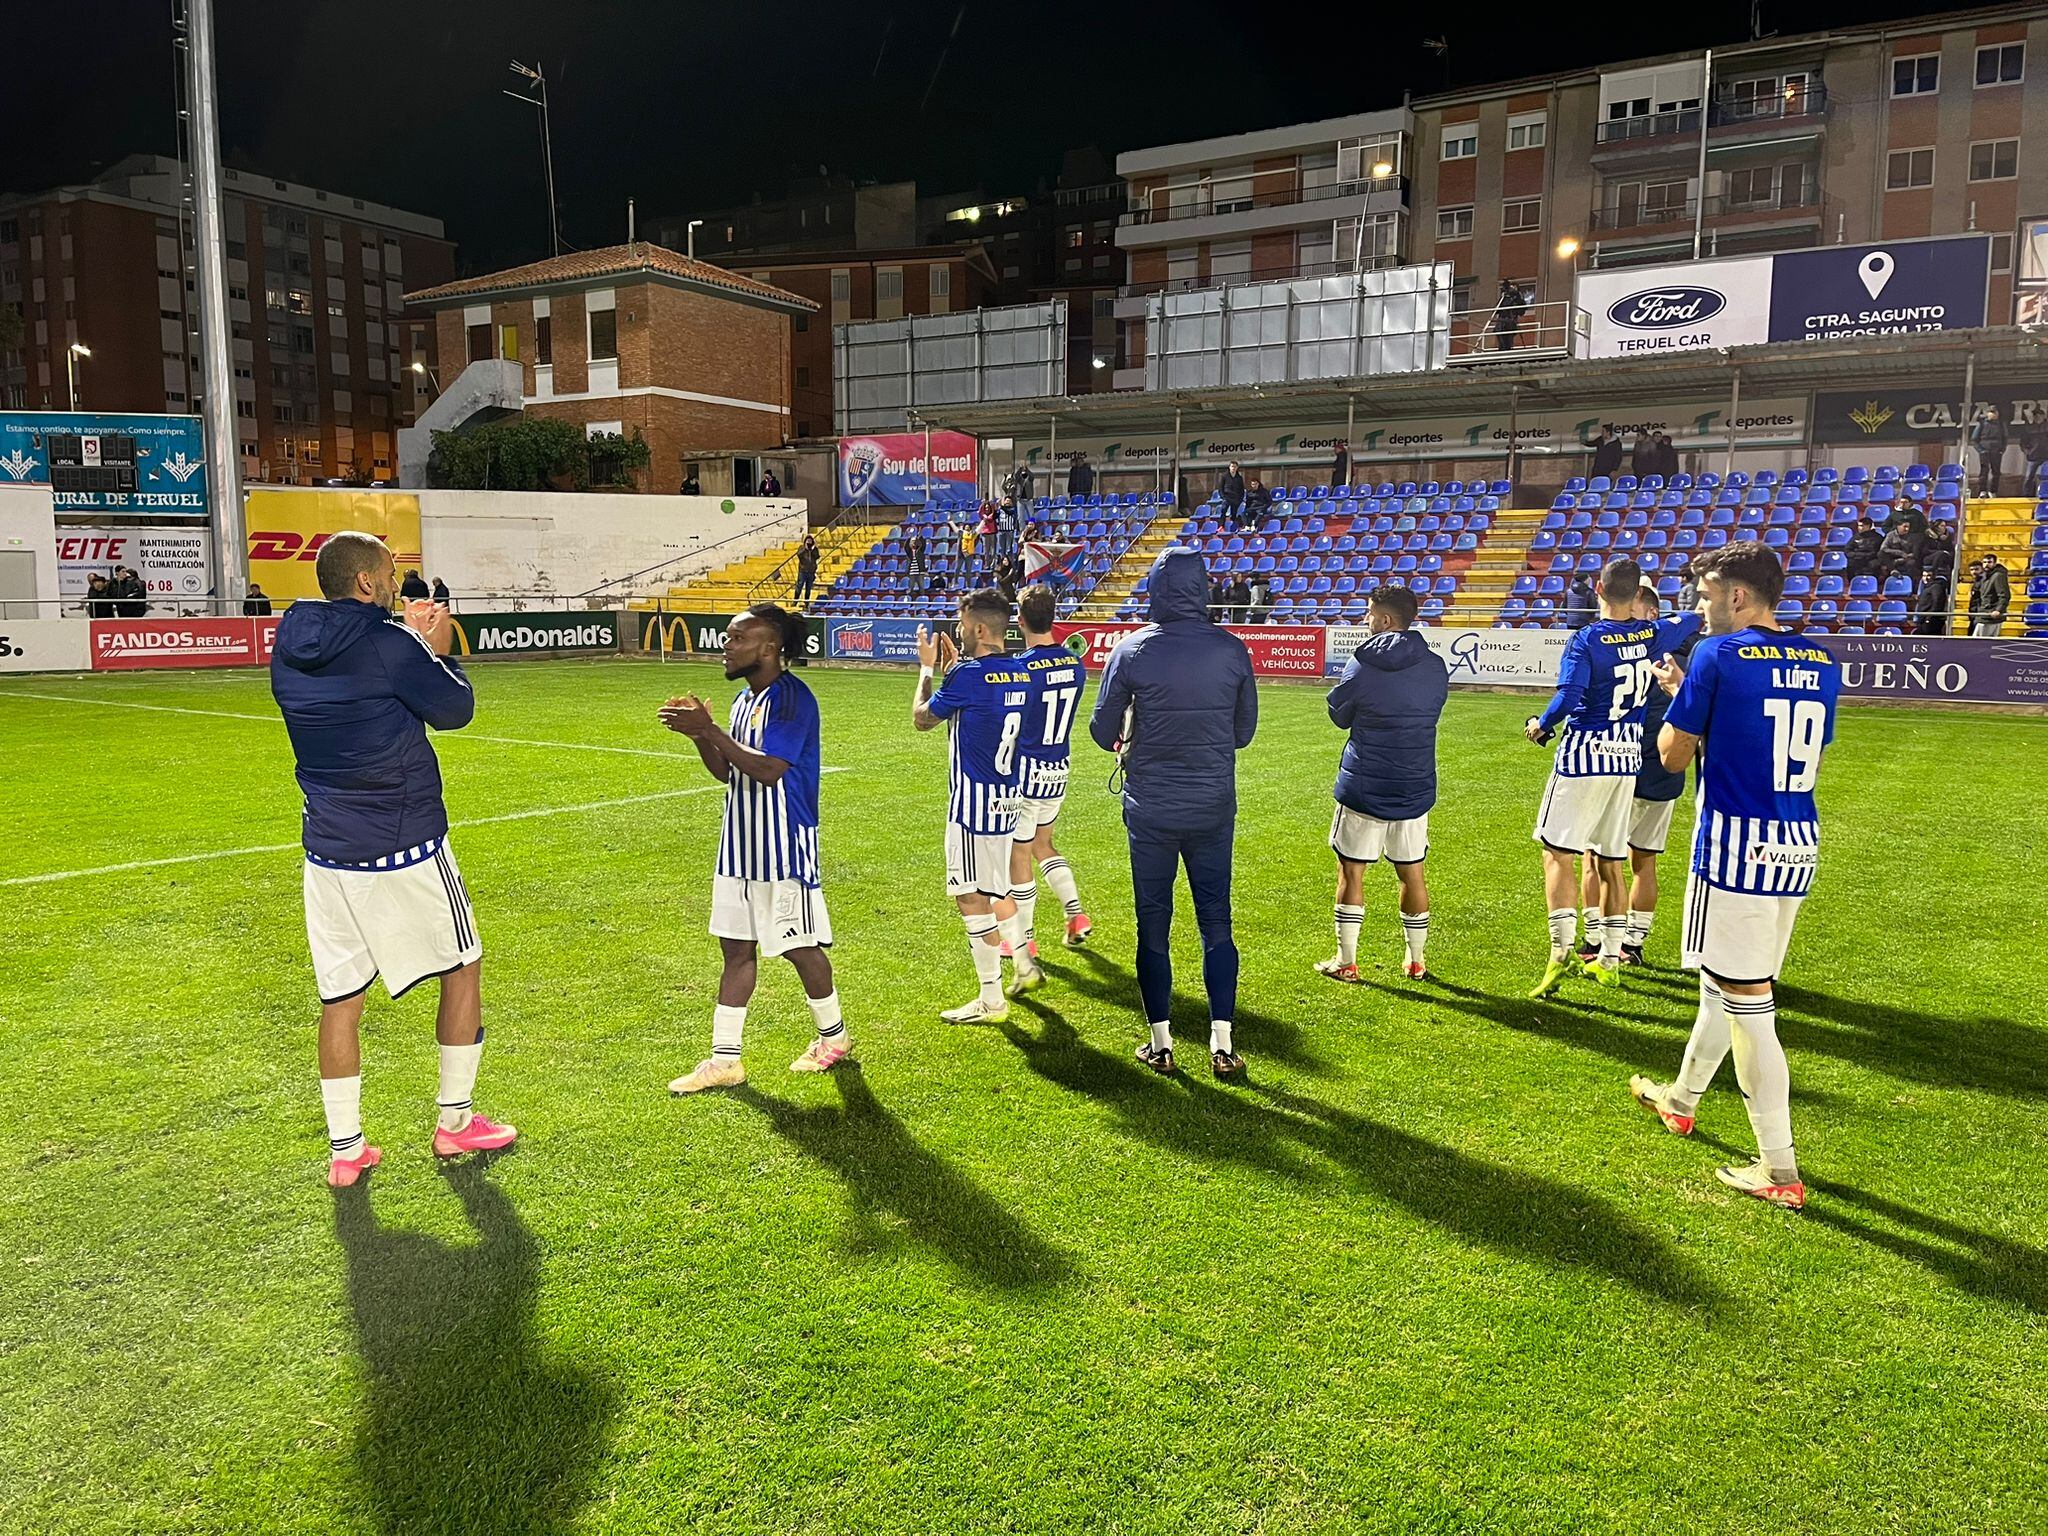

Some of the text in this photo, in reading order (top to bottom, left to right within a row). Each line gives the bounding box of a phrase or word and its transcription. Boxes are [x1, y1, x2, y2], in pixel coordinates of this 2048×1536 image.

[1630, 293, 1702, 323] Ford
[1805, 305, 1945, 329] CTRA. SAGUNTO
[1617, 333, 1711, 351] TERUEL CAR
[5, 424, 39, 434] Estamos
[128, 426, 151, 435] Como
[1389, 433, 1443, 446] deportes
[1125, 447, 1168, 458] deportes
[1208, 442, 1255, 454] deportes
[883, 458, 906, 475] Soy
[931, 454, 971, 472] Teruel
[105, 493, 128, 505] DE
[134, 493, 202, 506] TERUEL
[139, 539, 201, 548] MANTENIMIENTO
[140, 549, 199, 558] DE CALEFACCIÓN
[141, 560, 205, 569] Y CLIMATIZACIÓN
[158, 580, 173, 591] 08
[98, 632, 193, 648] FANDOS
[478, 625, 613, 650] McDonald's
[1600, 634, 1627, 644] CAJA
[1271, 648, 1315, 657] RÓTULOS
[1450, 632, 1521, 663] Gómez
[1738, 646, 1783, 660] CAJA
[1847, 643, 1928, 652] LA VIDA ES
[1027, 658, 1053, 670] CAJA
[1262, 660, 1315, 670] VEHÍCULOS
[1525, 660, 1546, 674] s.l.
[985, 672, 1010, 684] CAJA
[1785, 665, 1820, 690] LÓPEZ
[1608, 658, 1652, 721] 20
[1042, 686, 1078, 746] 17
[995, 711, 1021, 776] 8
[1763, 698, 1826, 792] 19
